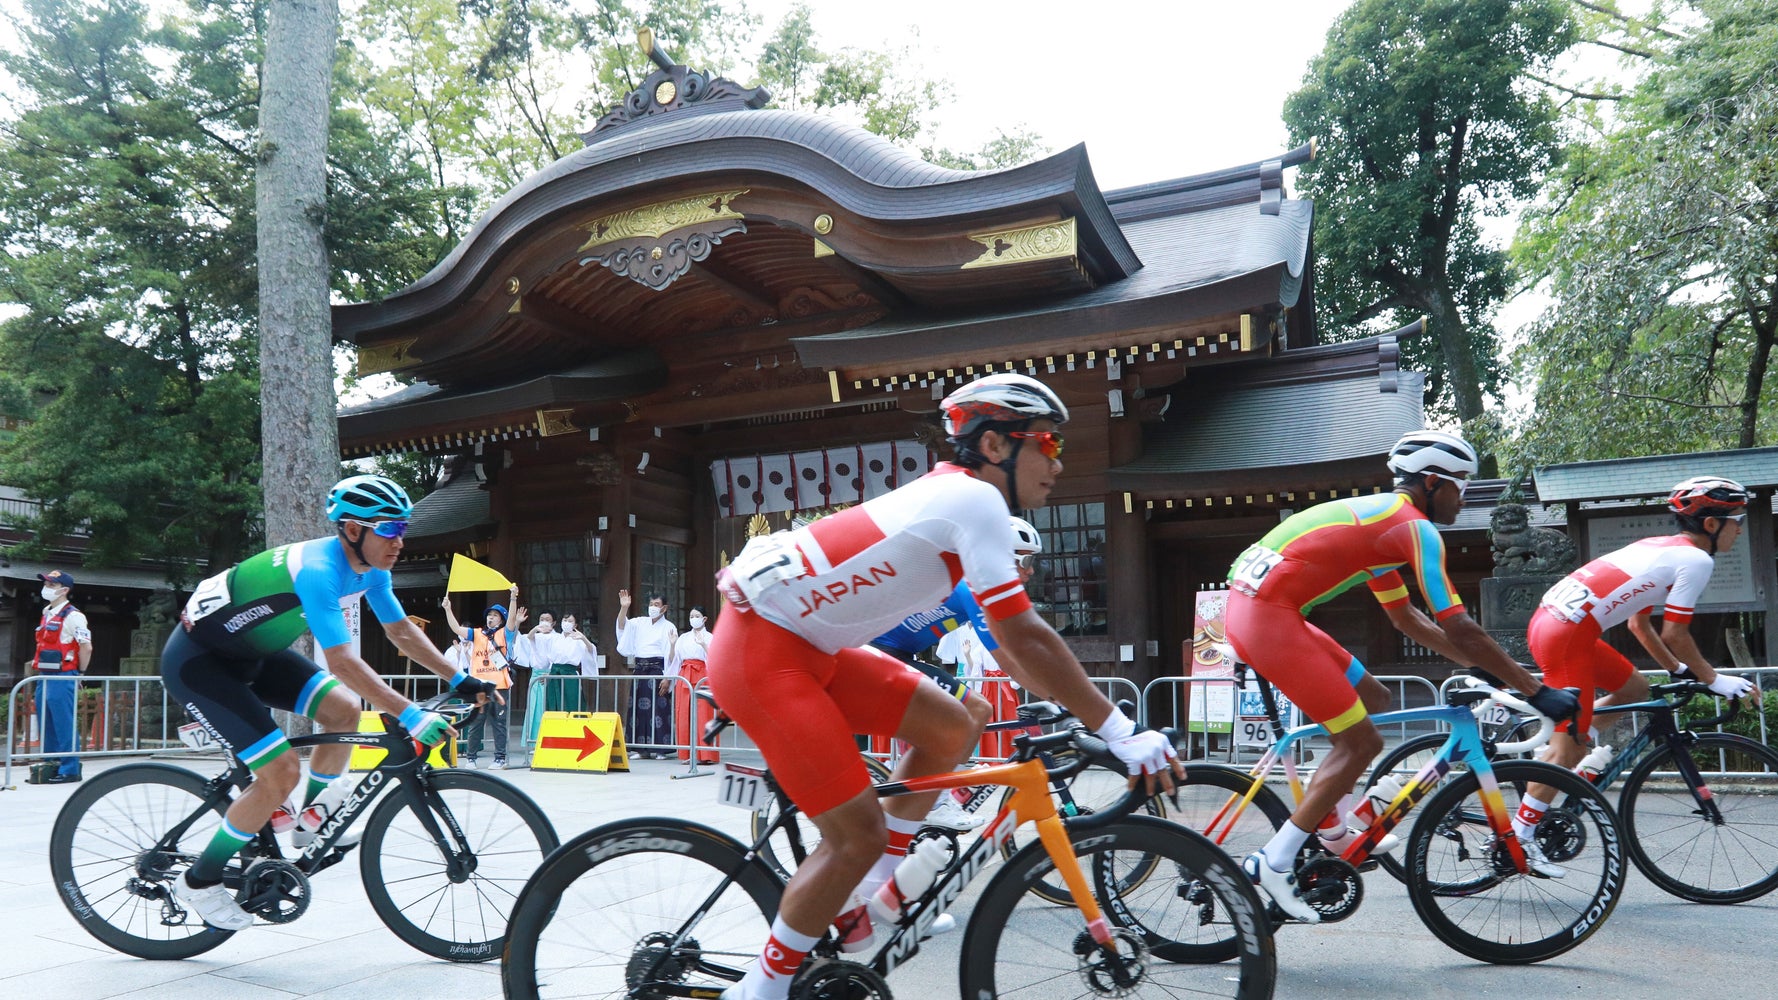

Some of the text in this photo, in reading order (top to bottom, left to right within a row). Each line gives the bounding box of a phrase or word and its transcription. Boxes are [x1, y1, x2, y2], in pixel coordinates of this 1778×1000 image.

[799, 561, 897, 618] JAPAN
[1604, 581, 1656, 615] JAPAN
[224, 604, 274, 634] UZBEKISTAN
[185, 702, 234, 749] UZBEKISTAN
[189, 729, 211, 748] 12
[1244, 723, 1267, 741] 96
[724, 774, 757, 806] 111
[304, 770, 384, 860] PINARELLO
[1573, 797, 1620, 939] BONTRAGER
[886, 810, 1017, 976] MERIDA
[449, 943, 492, 955] Lightweight
